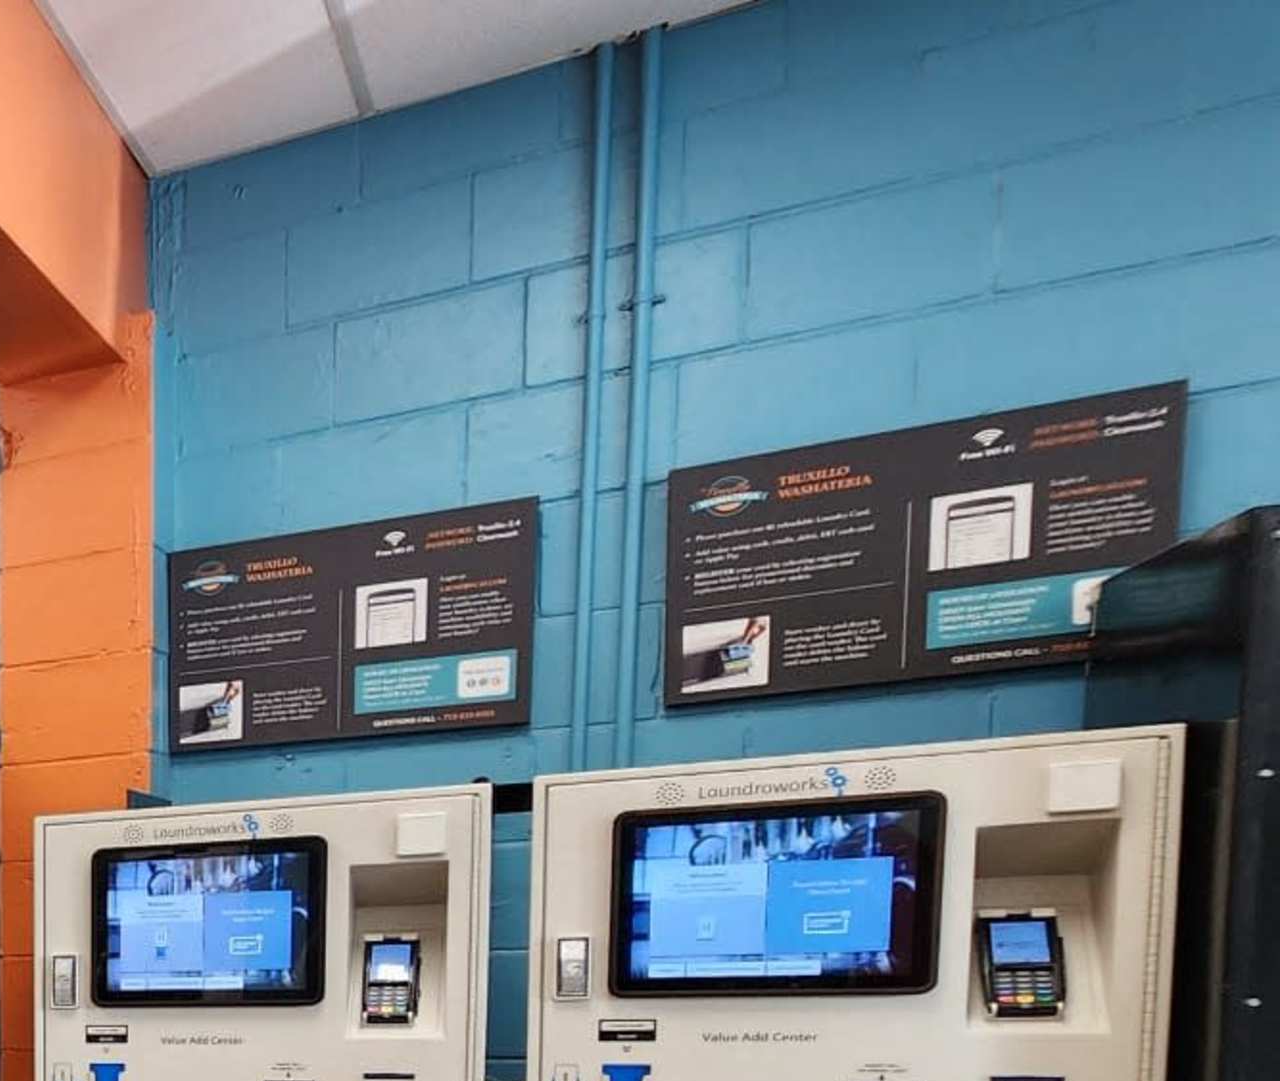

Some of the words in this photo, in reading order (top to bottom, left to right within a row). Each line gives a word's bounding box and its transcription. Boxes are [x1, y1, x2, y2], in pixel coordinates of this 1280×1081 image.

[778, 466, 850, 487] TRUXILLO
[777, 475, 873, 498] WASHATERIA
[246, 556, 298, 572] TRUXILLO
[950, 650, 1012, 664] QUESTIONS
[698, 776, 828, 800] Laundroworks
[153, 822, 246, 840] Laundroworks
[160, 1036, 186, 1046] Value
[190, 1036, 209, 1046] Add
[211, 1036, 242, 1046] Center
[702, 1032, 737, 1043] Value
[742, 1032, 768, 1043] Add
[773, 1031, 818, 1043] Center
